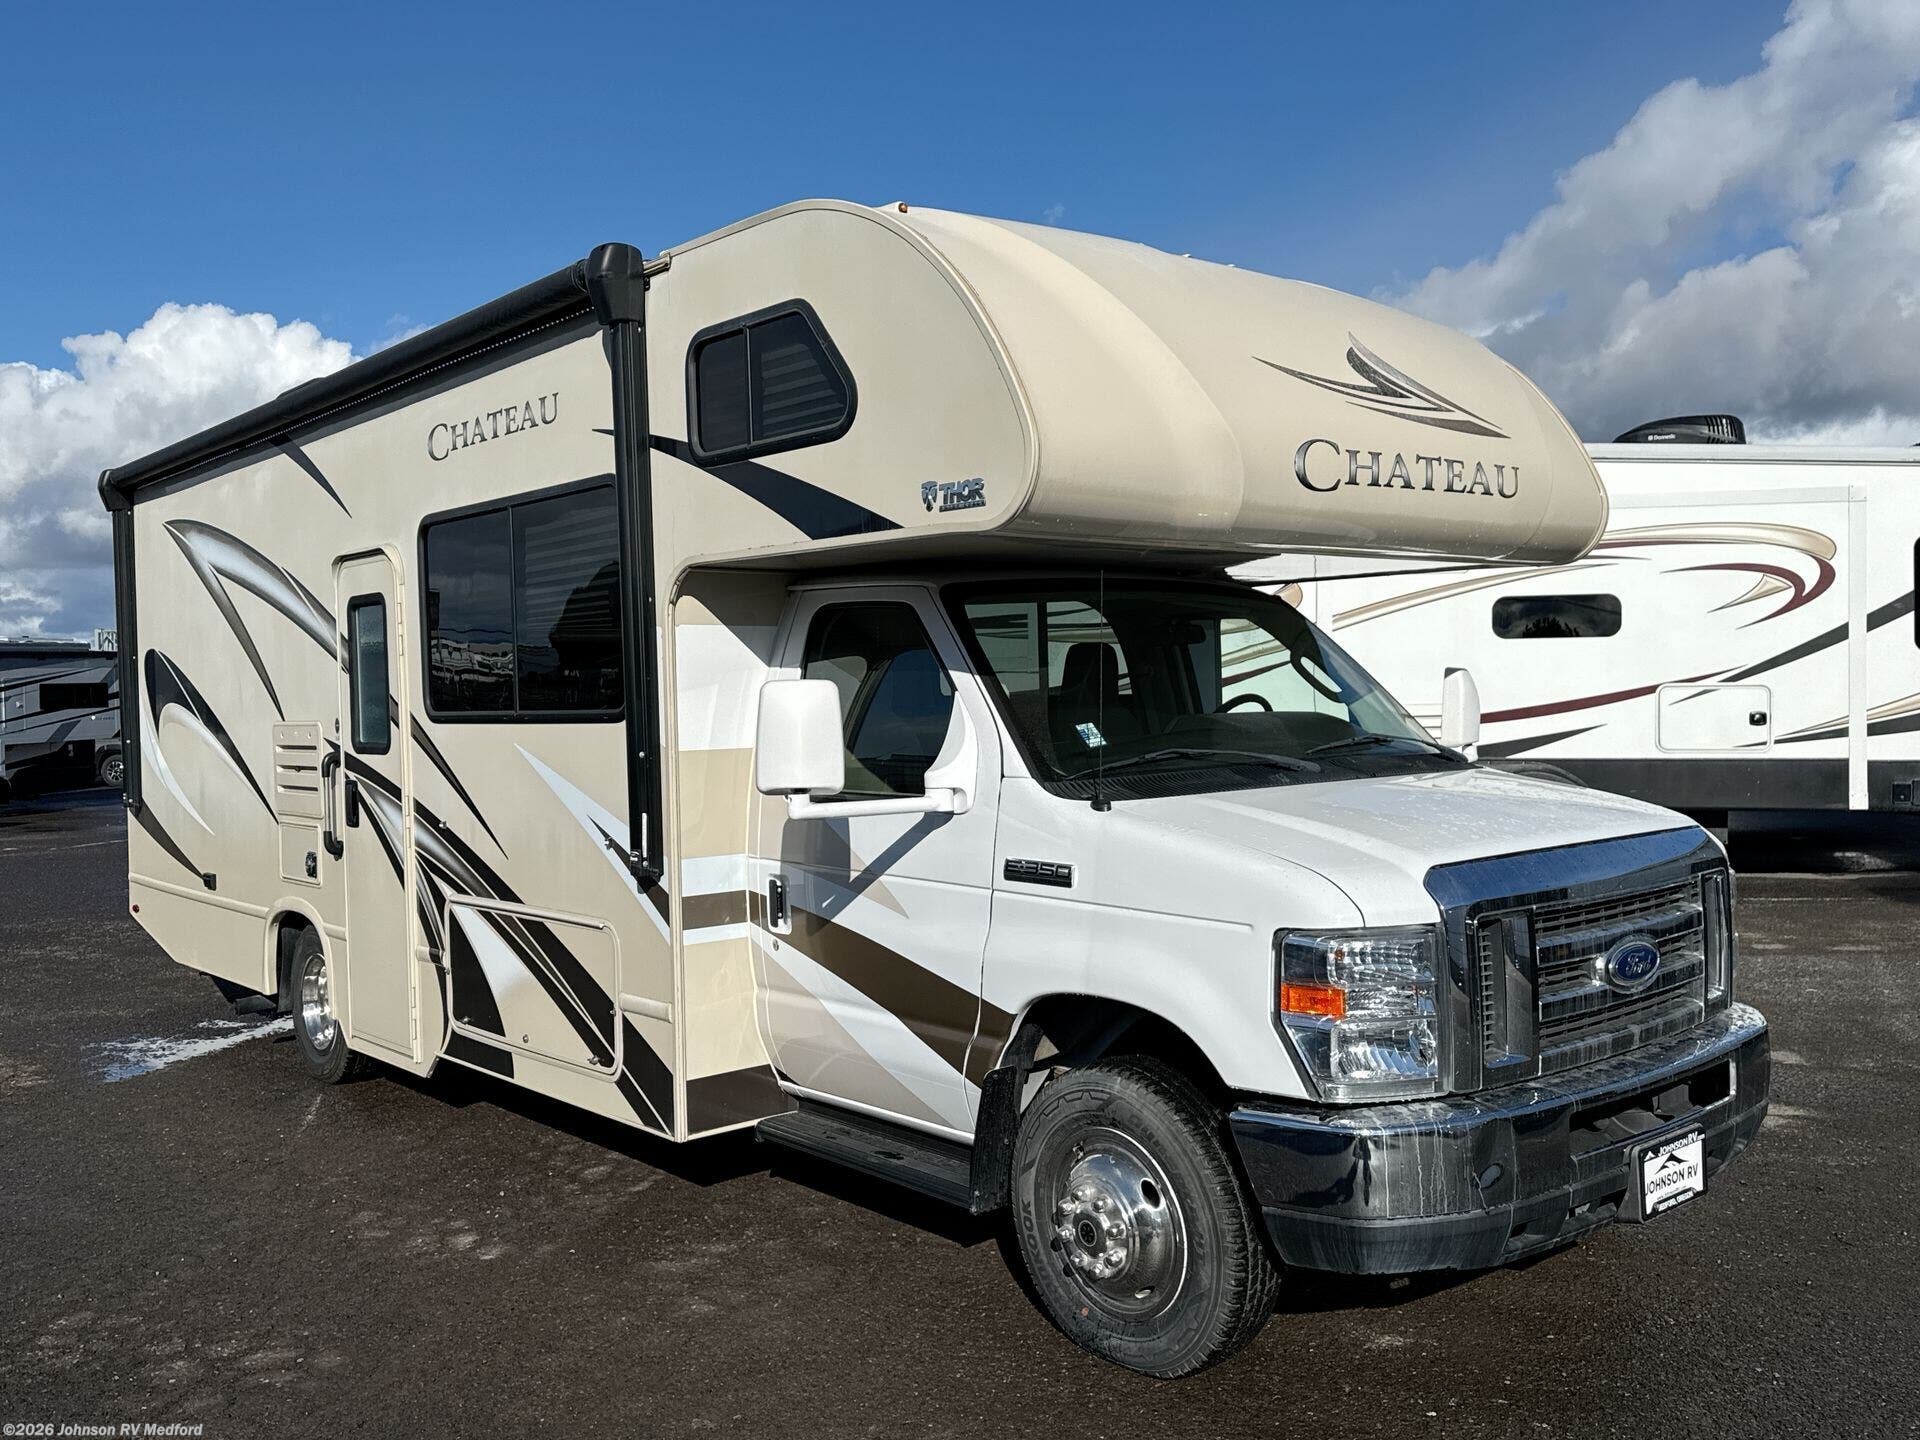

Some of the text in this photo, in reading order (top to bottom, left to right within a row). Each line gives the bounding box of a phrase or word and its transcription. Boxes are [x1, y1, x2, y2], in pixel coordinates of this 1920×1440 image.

[427, 392, 559, 461] CHATEAU
[1294, 439, 1519, 498] CHATEAU
[939, 478, 985, 505] THOR
[1645, 1168, 1685, 1195] JOHNSON
[1687, 1163, 1699, 1179] RV
